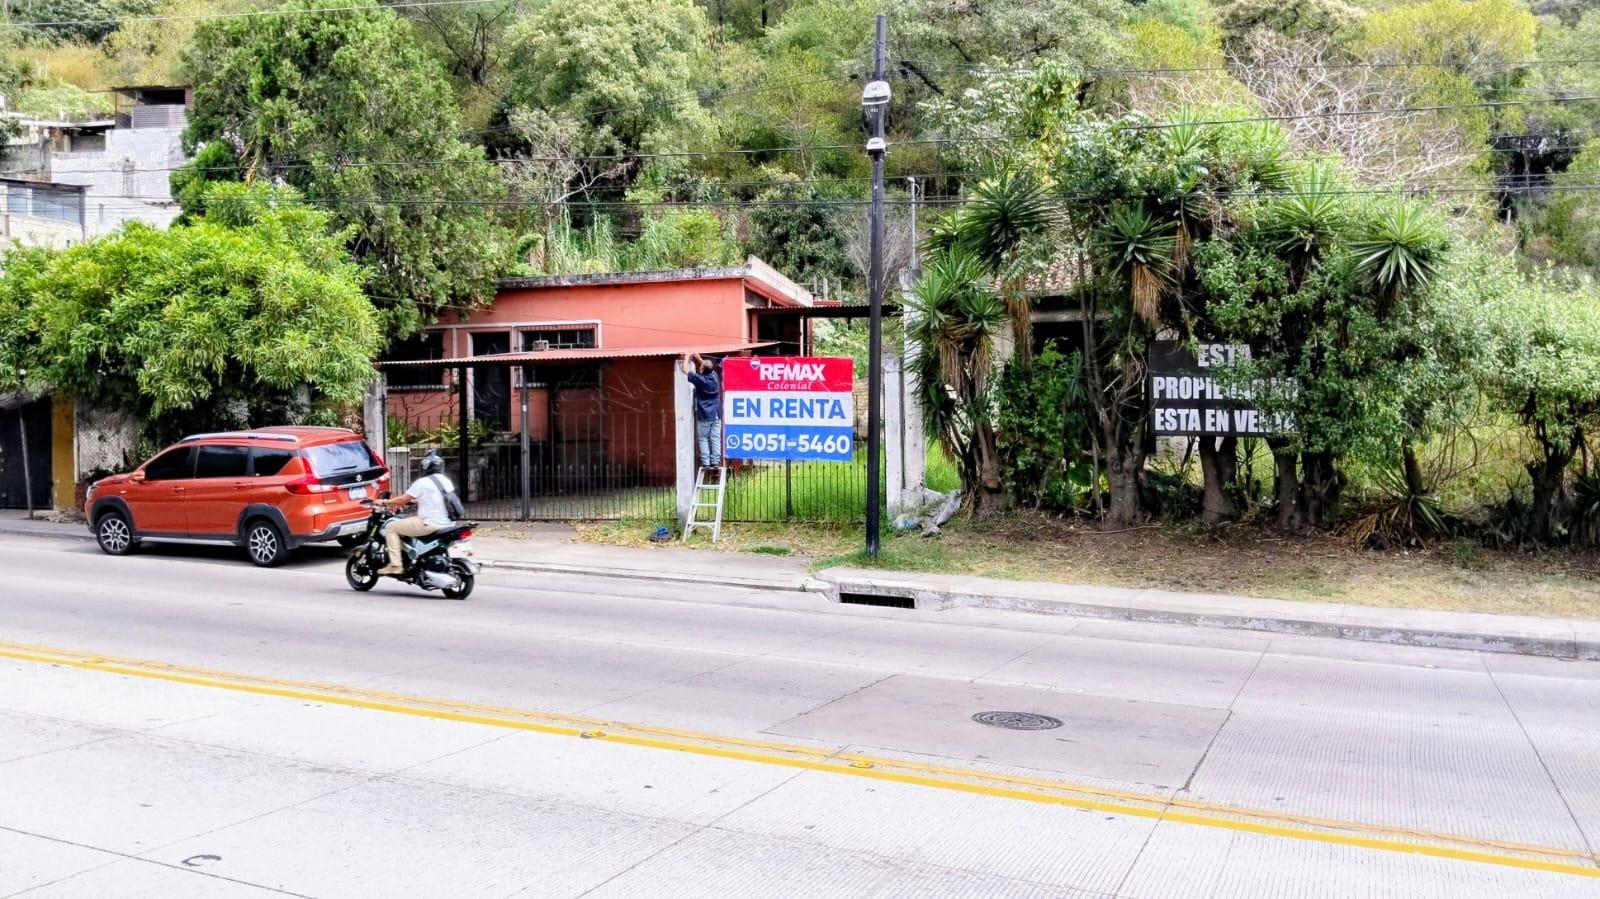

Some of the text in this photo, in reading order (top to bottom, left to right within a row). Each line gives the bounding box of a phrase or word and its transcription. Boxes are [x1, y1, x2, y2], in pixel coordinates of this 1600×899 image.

[1198, 343, 1252, 367] ESTA
[767, 381, 812, 390] Colonial
[1152, 376, 1265, 400] PROPIE
[732, 397, 846, 420] EN RENTA
[1155, 408, 1201, 431] ESTA
[1205, 409, 1229, 432] EN
[741, 433, 850, 454] 5051-5460
